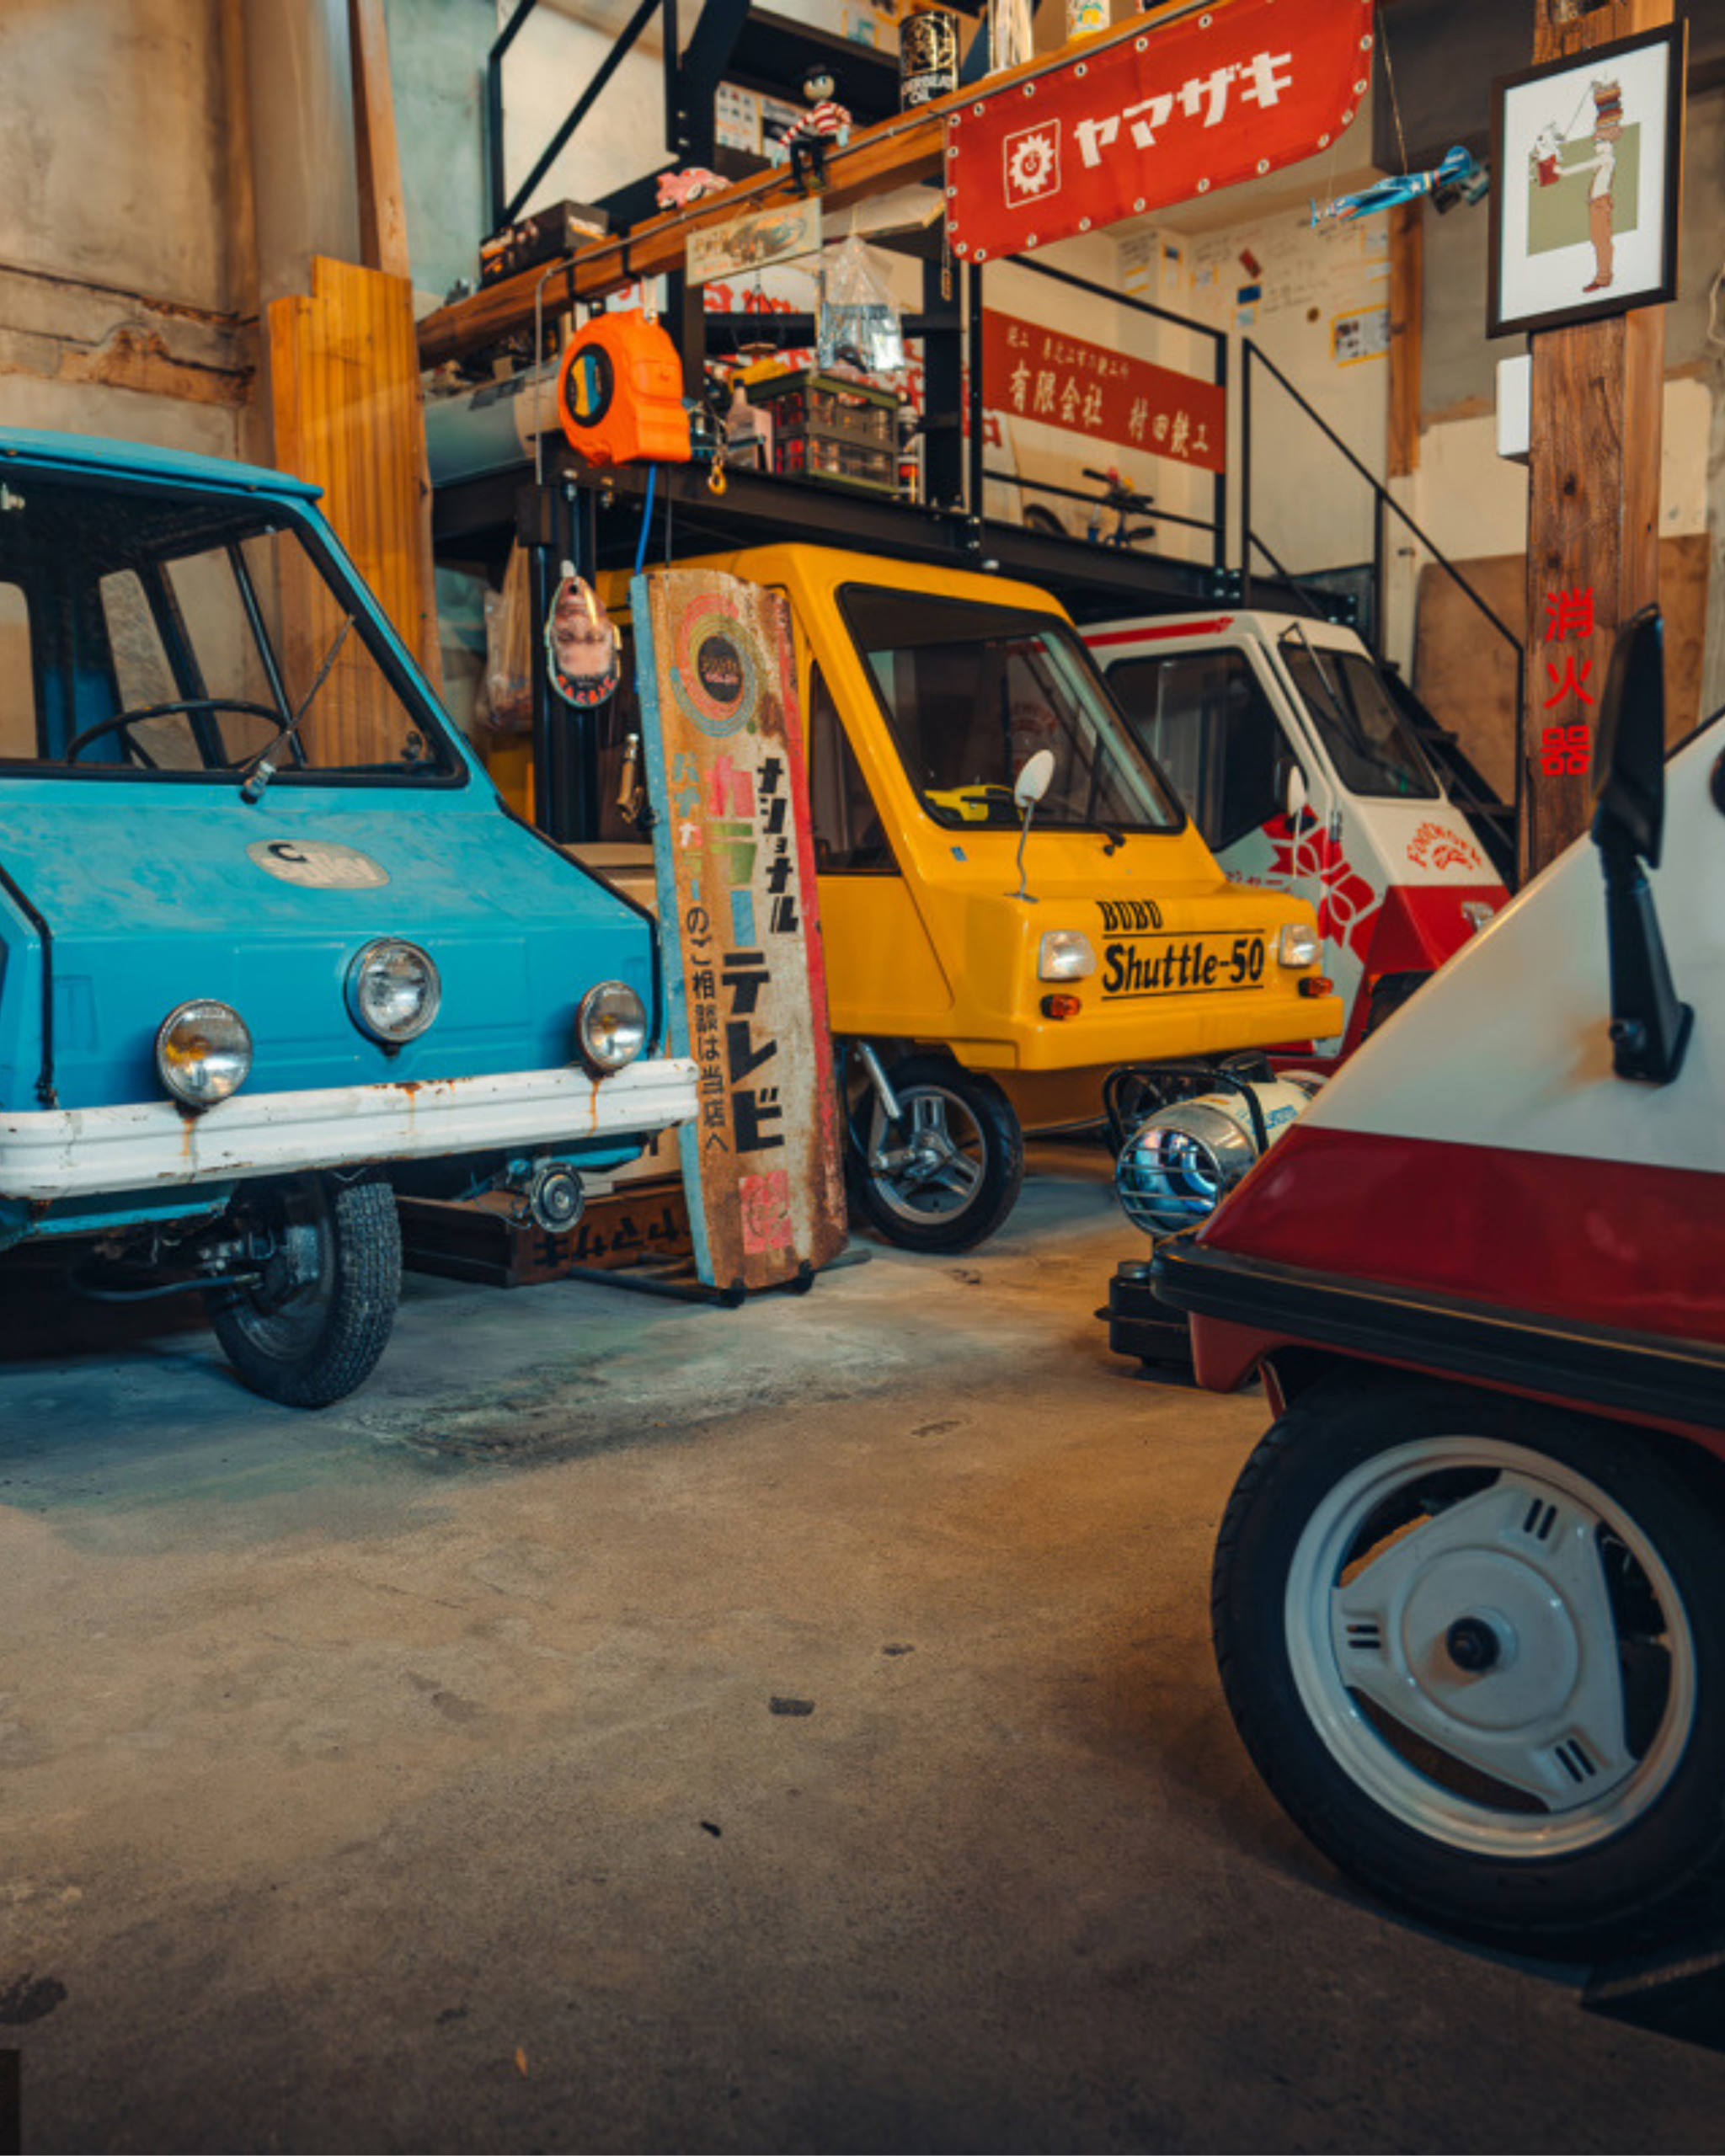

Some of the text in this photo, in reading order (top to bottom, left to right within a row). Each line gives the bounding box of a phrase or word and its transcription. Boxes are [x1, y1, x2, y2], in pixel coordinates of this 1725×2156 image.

[1074, 51, 1292, 168] ヤマザキ
[1009, 359, 1103, 427] 有限会社
[1539, 585, 1594, 776] 消火器
[756, 757, 798, 934] ナショナル
[1103, 937, 1265, 993] Shuttle-50
